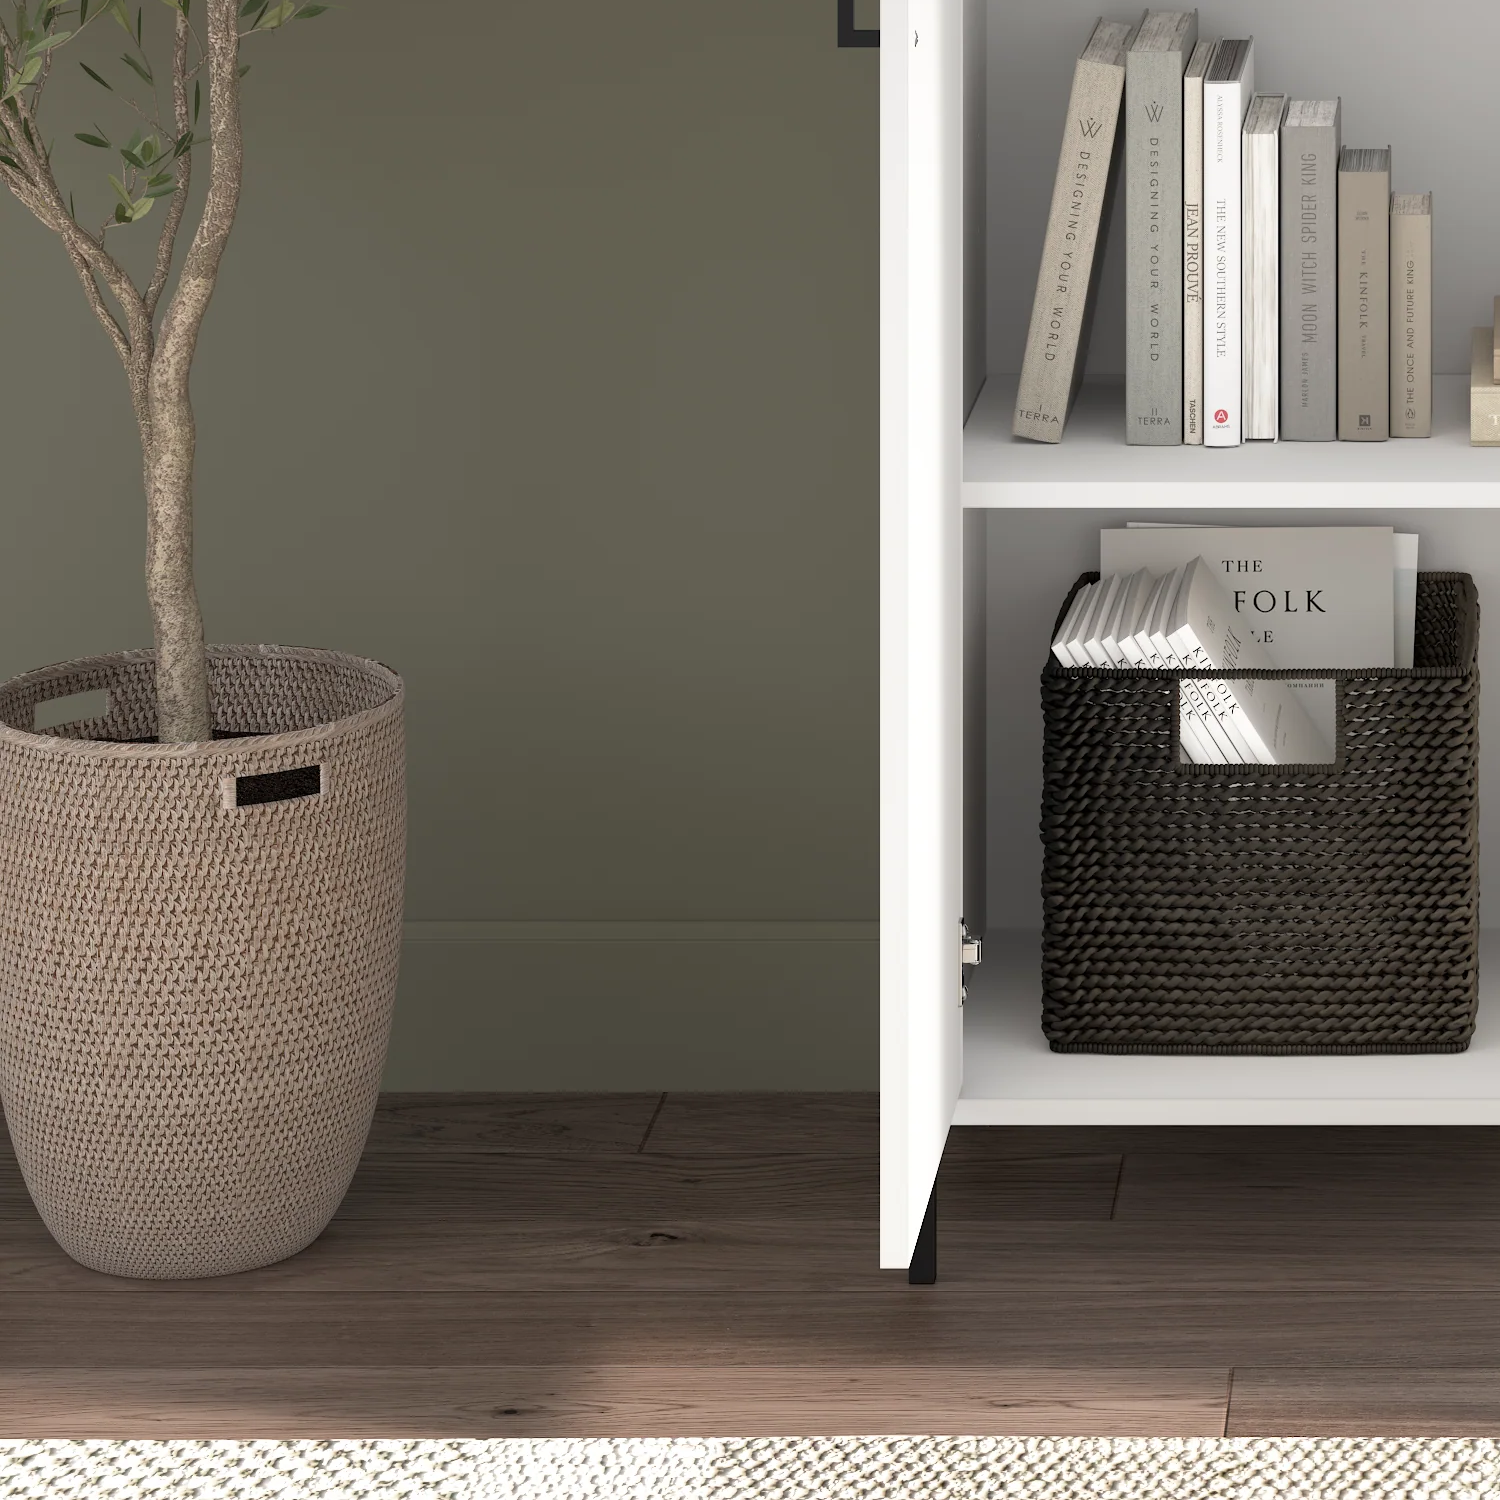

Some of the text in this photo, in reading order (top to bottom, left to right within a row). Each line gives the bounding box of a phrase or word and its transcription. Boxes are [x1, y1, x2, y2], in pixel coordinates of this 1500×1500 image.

[1045, 151, 1091, 361] DESIGNING YOUR WORLD
[1149, 138, 1159, 362] DESIGNING YOUR WORLD
[1185, 202, 1201, 303] JEAN PROUVÉ
[1301, 153, 1317, 343] MOON WITCH SPIDER KING
[1217, 199, 1226, 358] THE NEW SOUTHERN STYLE
[1406, 260, 1414, 285] KING
[1406, 288, 1414, 323] FUTURE
[1406, 327, 1414, 349] AND
[1406, 353, 1414, 383] ONCE
[1406, 388, 1414, 404] THE
[1019, 409, 1059, 425] TERRA
[1138, 417, 1170, 426] TERRA
[1221, 560, 1263, 573] THE
[1233, 590, 1327, 613] FOLK
